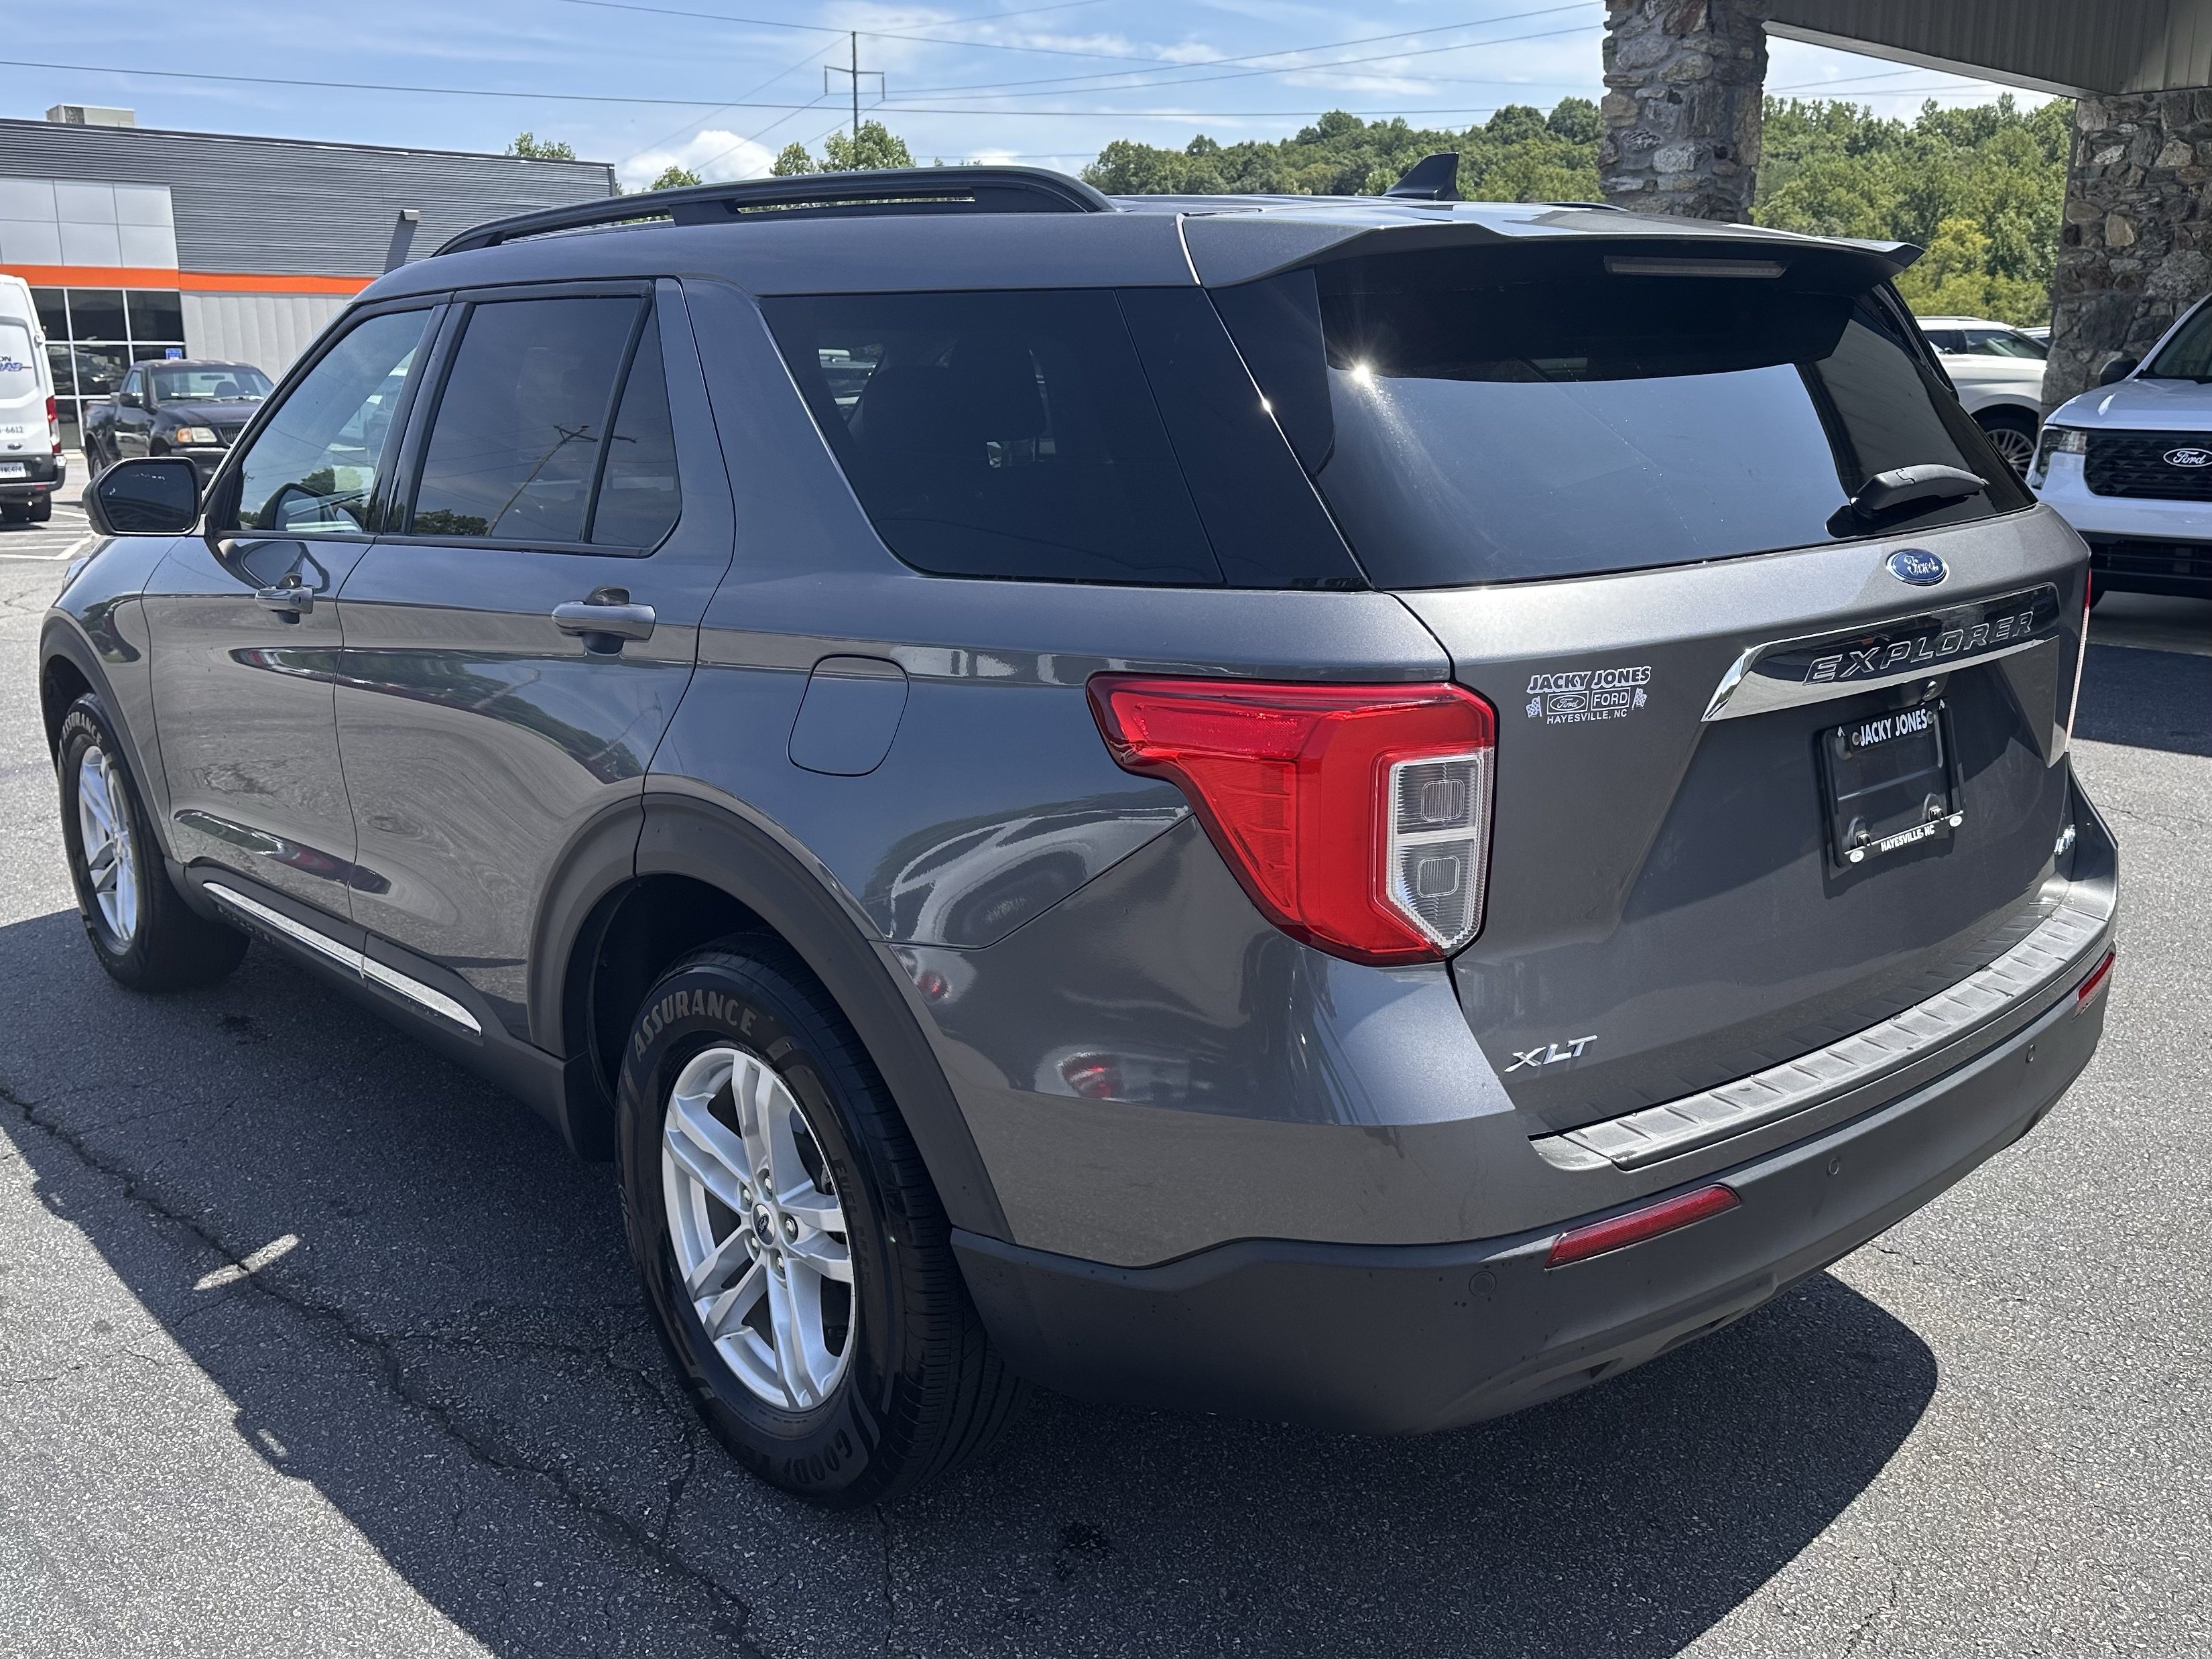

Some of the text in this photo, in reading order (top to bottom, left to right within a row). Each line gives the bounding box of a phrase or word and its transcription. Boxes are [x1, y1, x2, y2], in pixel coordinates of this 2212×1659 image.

[2173, 450, 2206, 464] Ford
[1904, 555, 1939, 576] Ford
[1802, 611, 2033, 686] EXPLORER
[1527, 666, 1651, 694] JACKY JONES
[1557, 692, 1627, 709] Ford FORD
[62, 711, 103, 747] ASSURANCE
[1547, 709, 1627, 724] HAYESVILLE, NC
[1860, 709, 1928, 746] JACKY JONES
[1924, 824, 1935, 837] NC
[633, 988, 757, 1064] ASSURANCE
[1504, 1035, 1598, 1072] XLT
